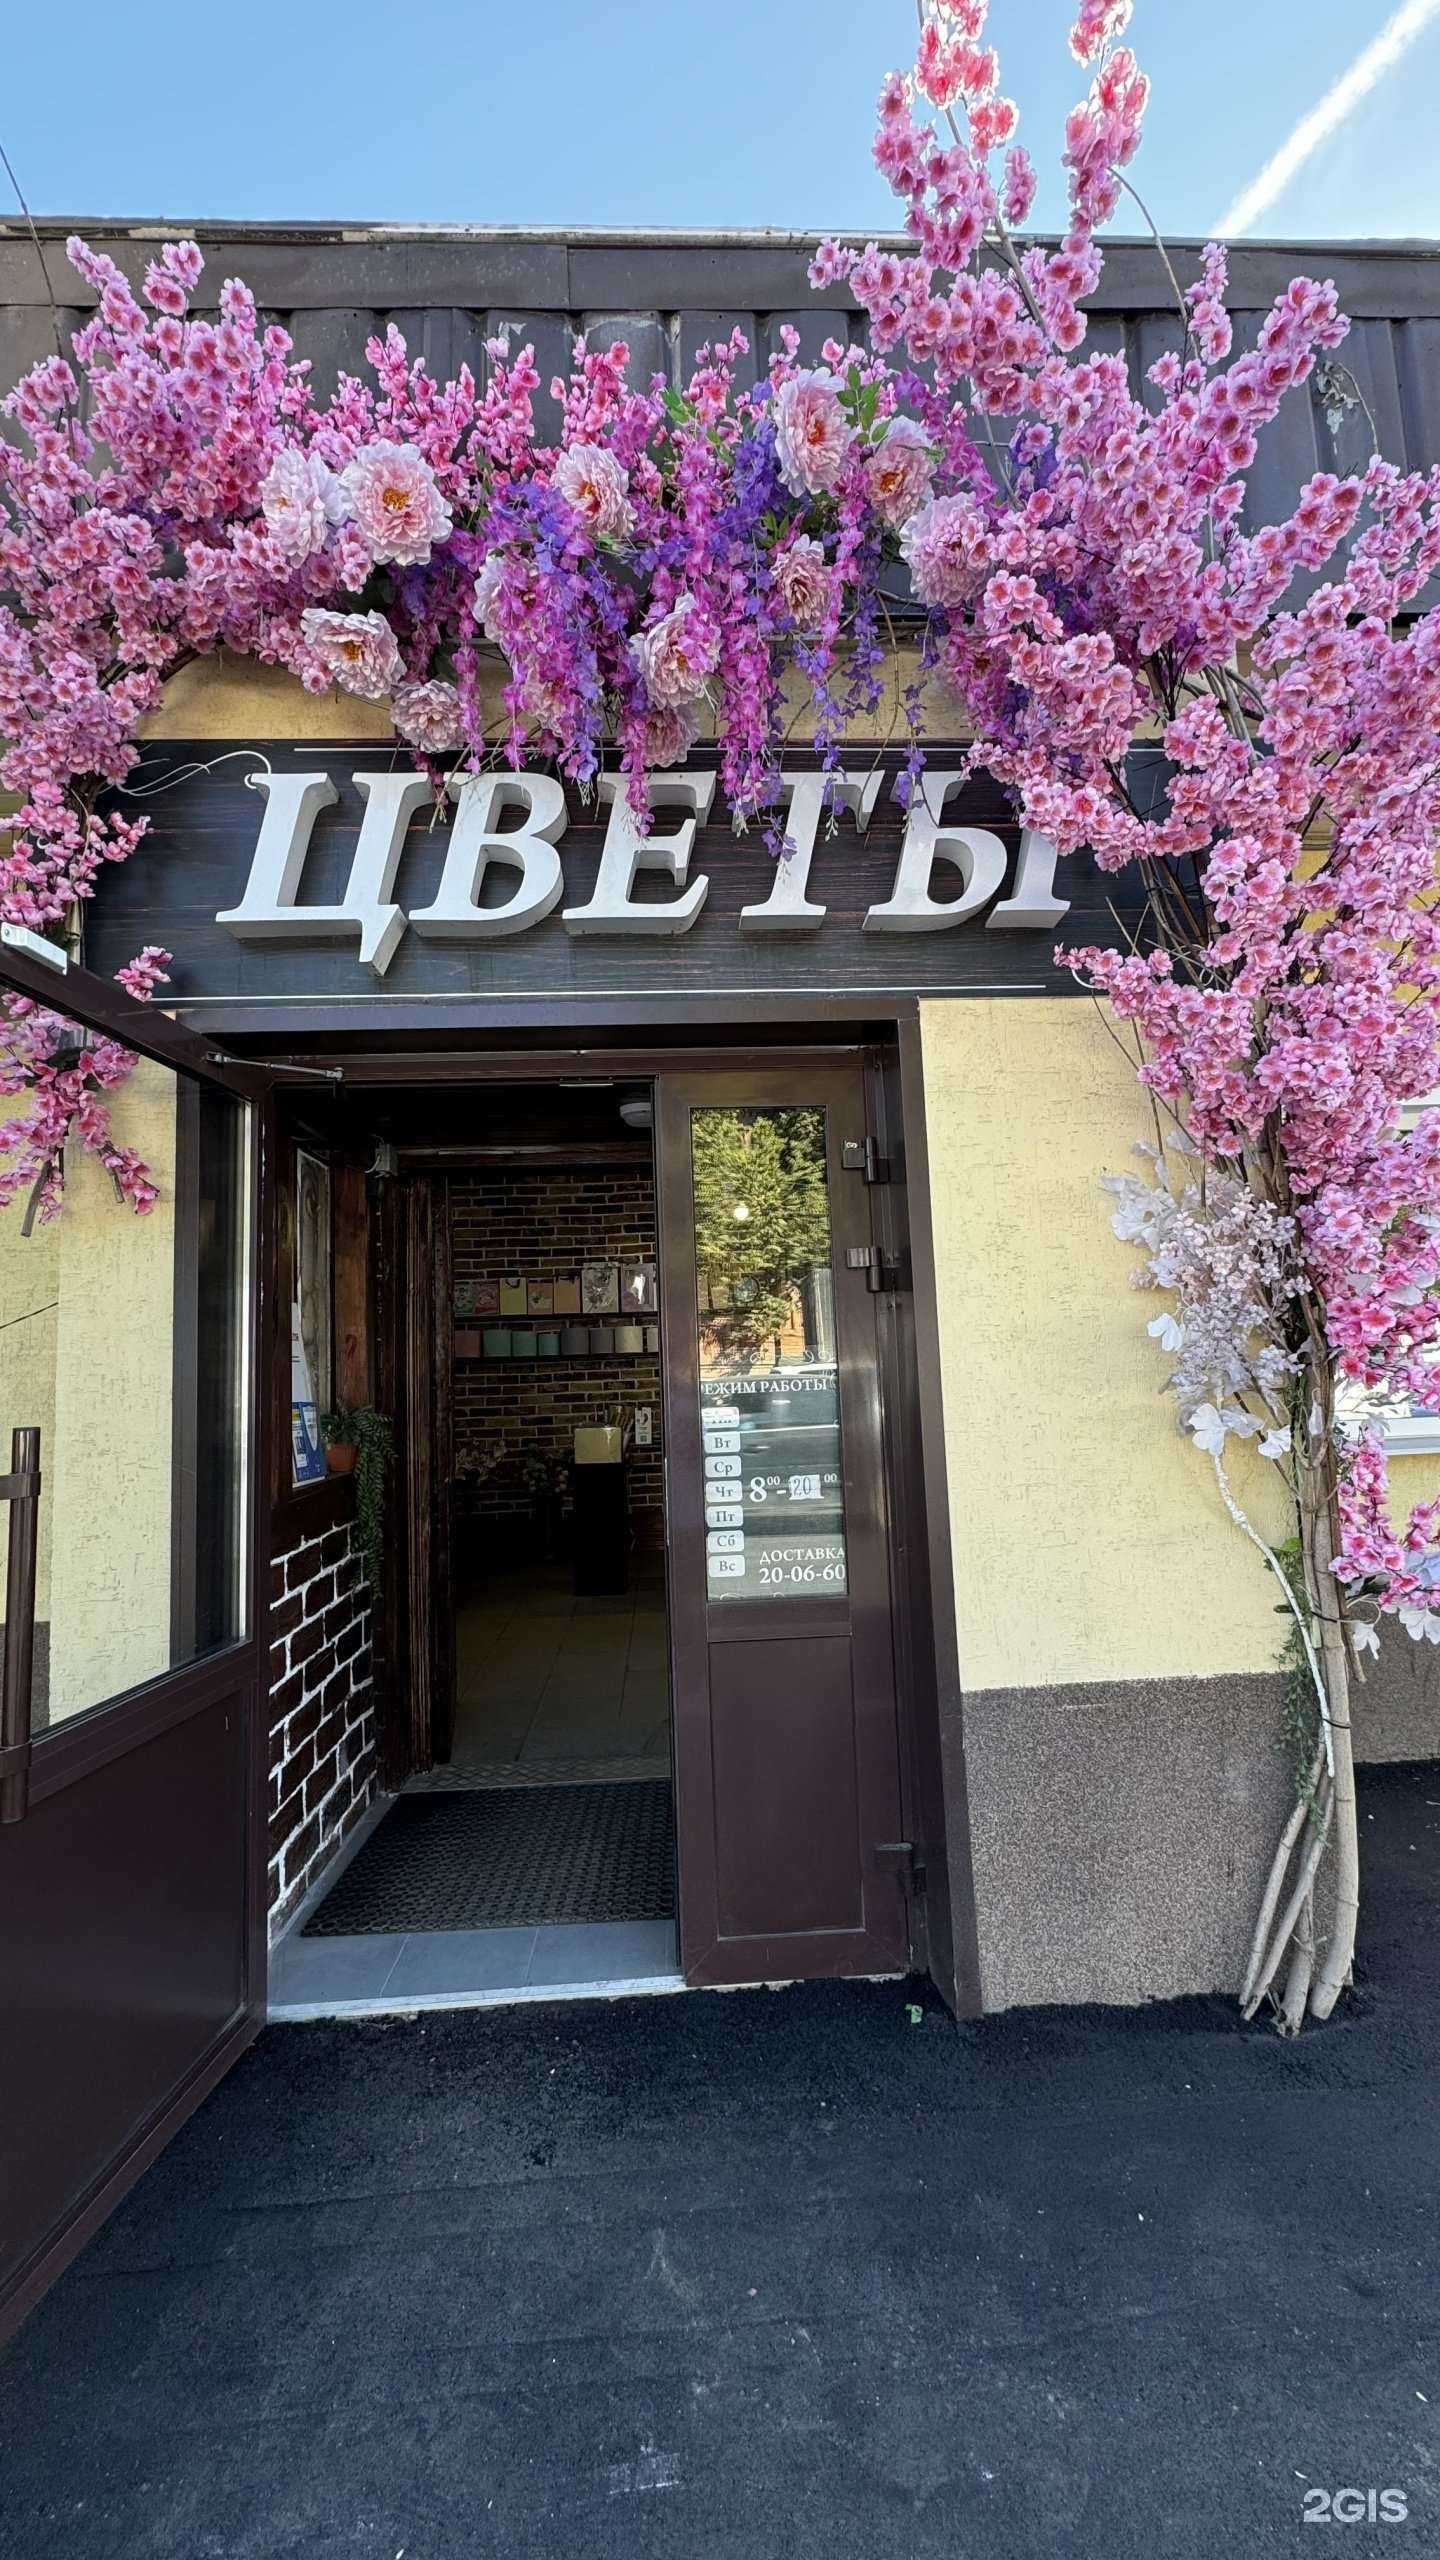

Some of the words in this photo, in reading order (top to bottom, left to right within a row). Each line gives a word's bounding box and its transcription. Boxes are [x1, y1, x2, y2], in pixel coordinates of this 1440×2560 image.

[214, 769, 1072, 977] ЦВЕТЫ
[760, 1378, 827, 1393] РАБОТЫ
[715, 1437, 731, 1449] Вт
[714, 1461, 733, 1475] Ср
[716, 1486, 733, 1498] Чт
[716, 1510, 735, 1522] Пт
[717, 1534, 735, 1547] Сб
[759, 1547, 845, 1565] ДОСТАВКА
[719, 1560, 735, 1572] Вс
[759, 1563, 846, 1584] 20-06-60
